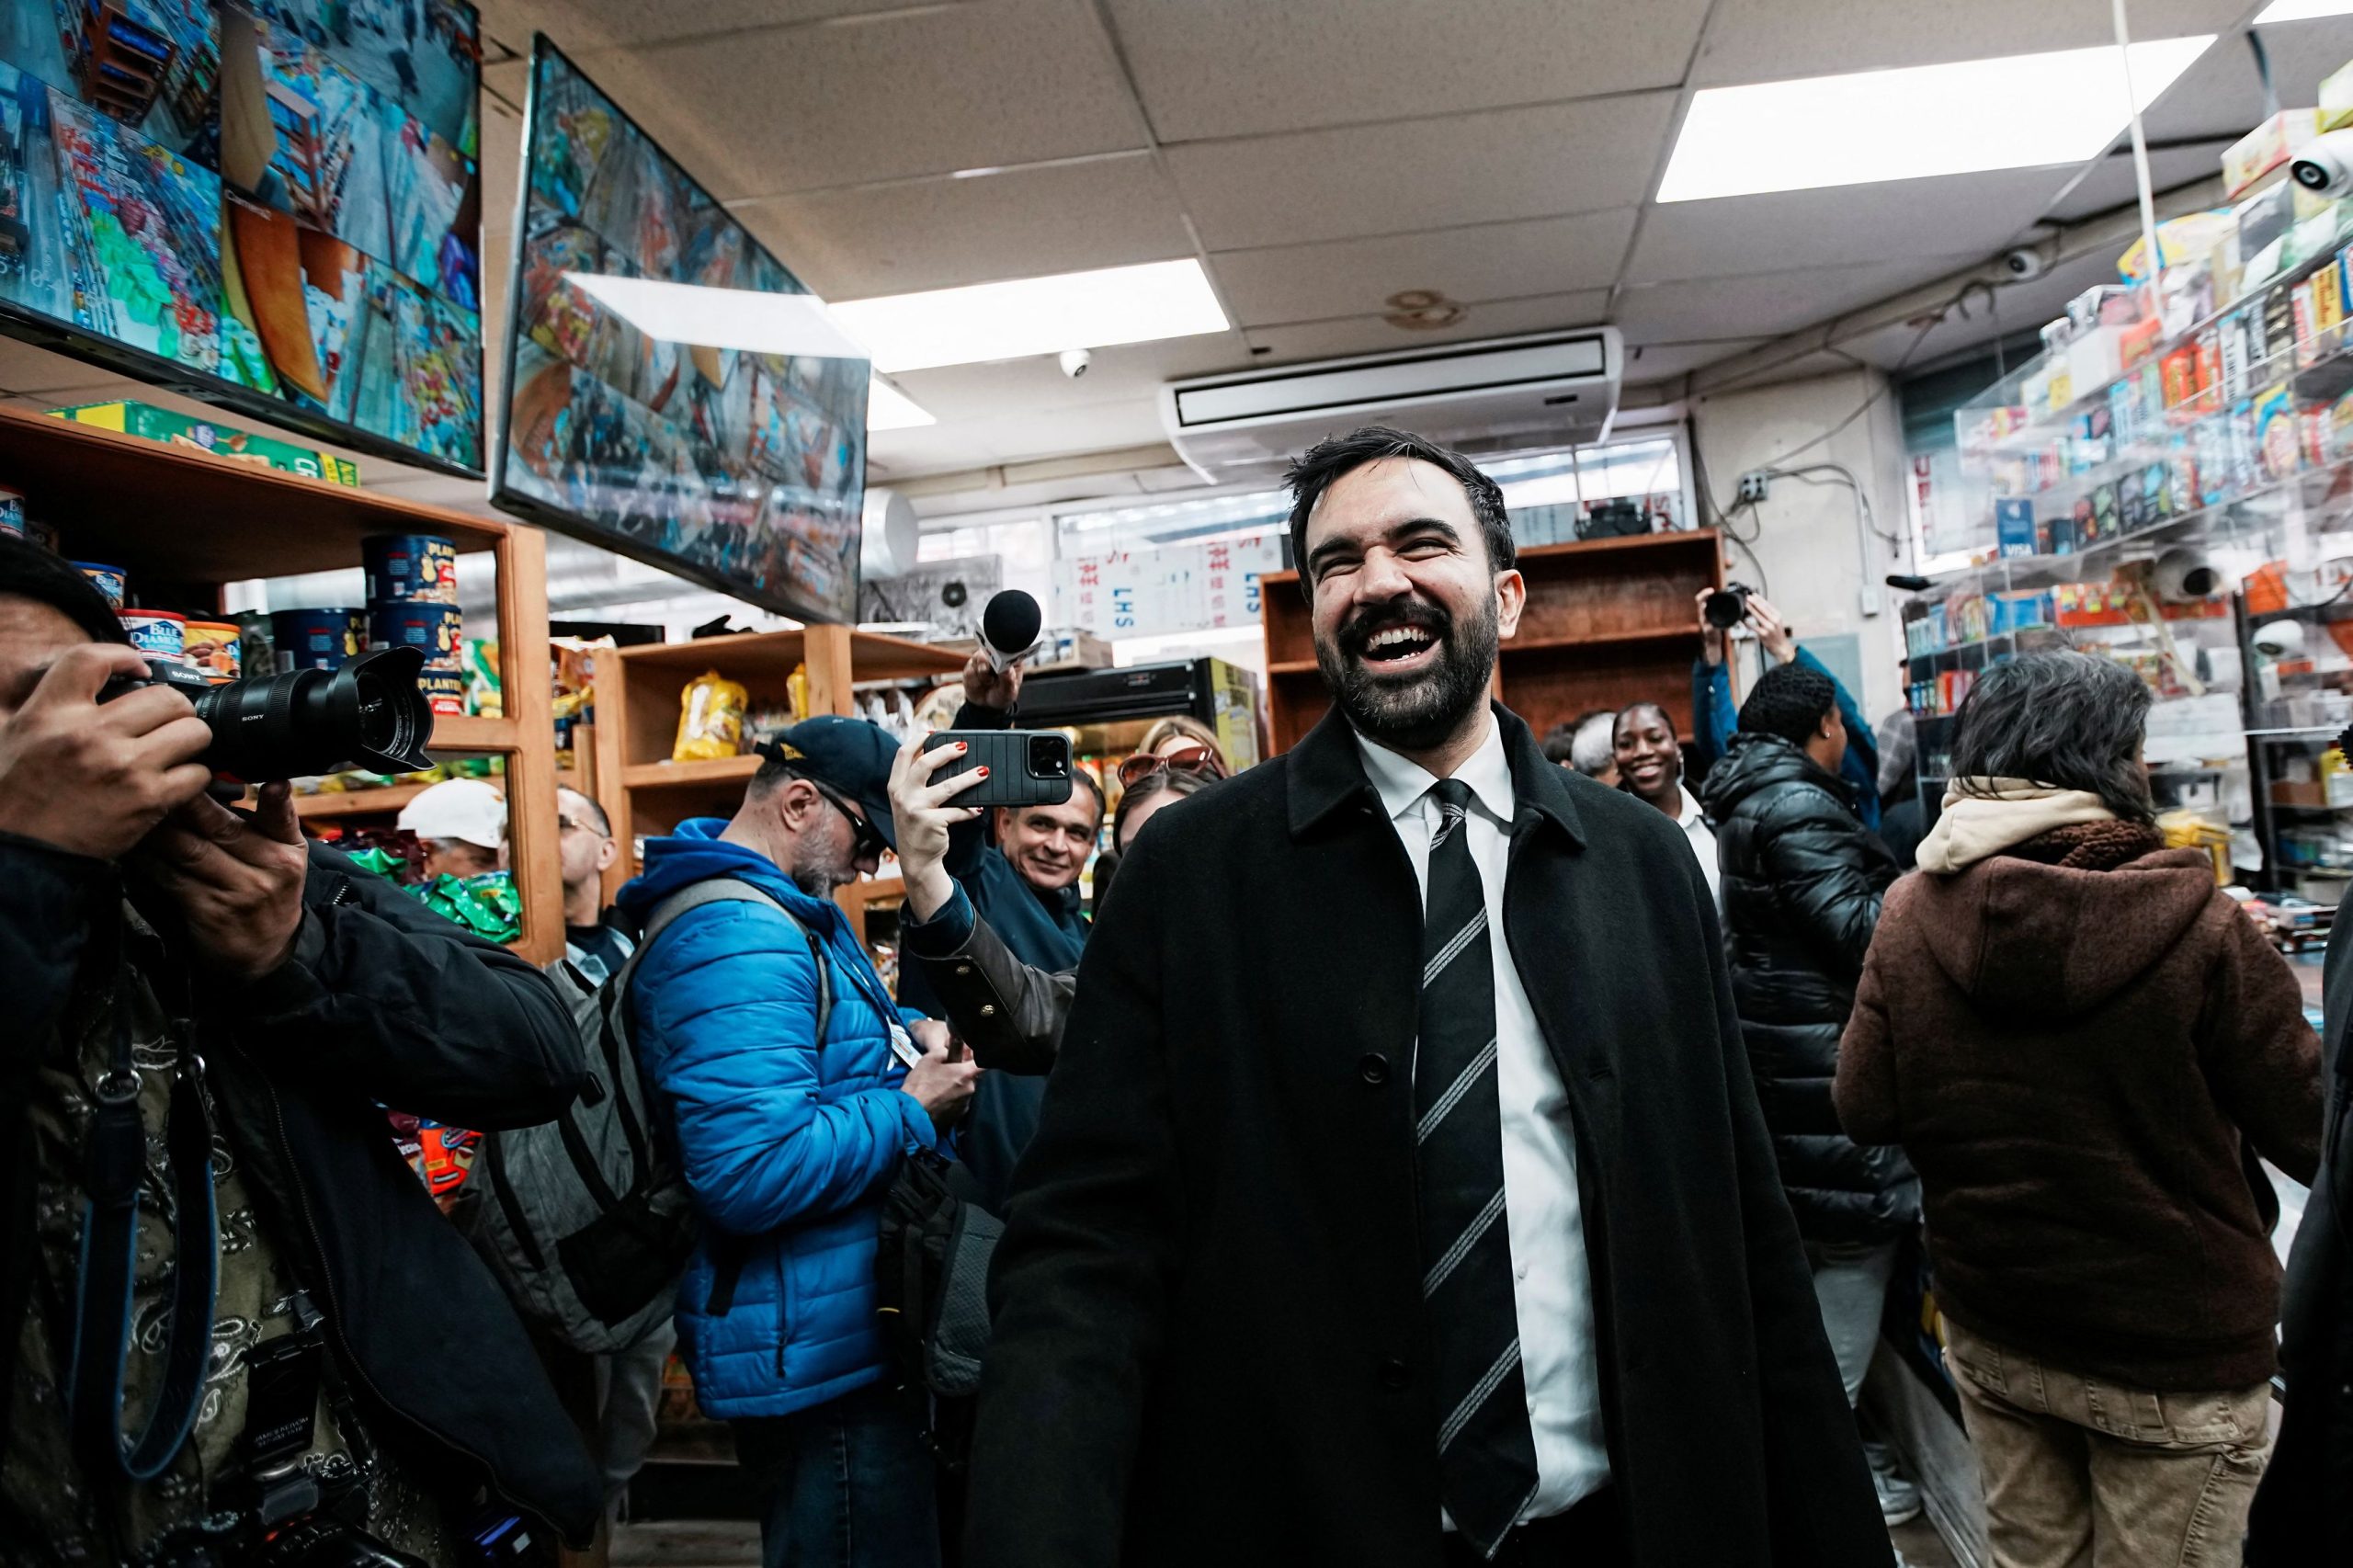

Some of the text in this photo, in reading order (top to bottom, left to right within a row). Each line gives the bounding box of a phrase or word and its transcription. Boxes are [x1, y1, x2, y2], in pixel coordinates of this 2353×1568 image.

[1113, 588, 1133, 627] LHS
[149, 624, 177, 636] BLUE
[171, 670, 200, 681] SONY
